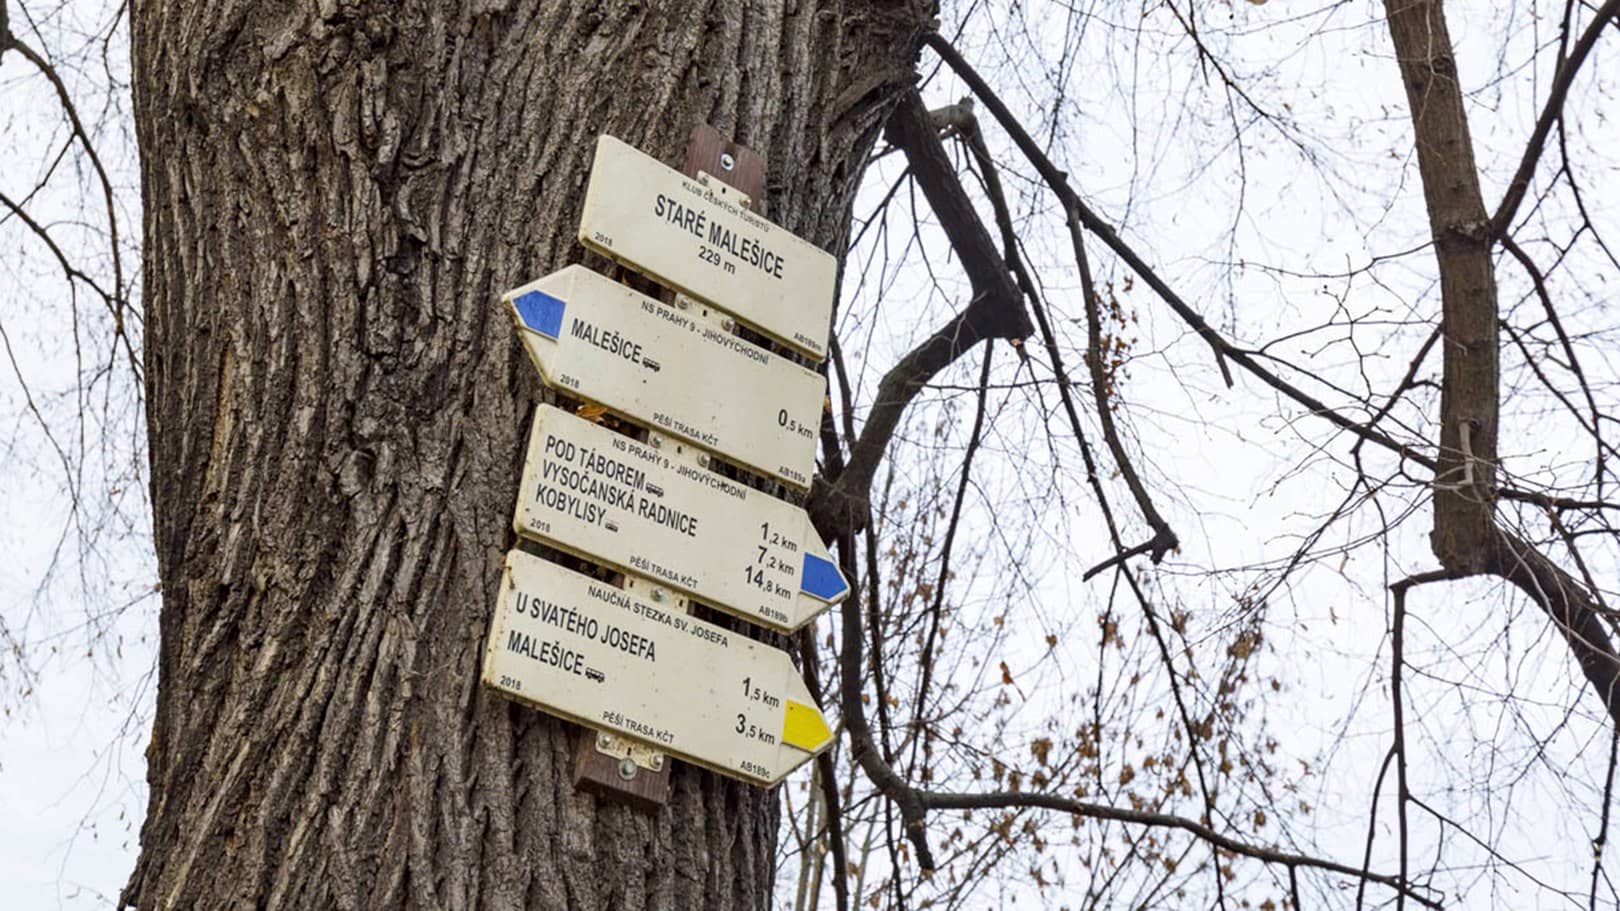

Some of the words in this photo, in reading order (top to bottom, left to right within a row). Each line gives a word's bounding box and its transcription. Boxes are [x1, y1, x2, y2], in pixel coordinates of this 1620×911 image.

[682, 180, 703, 197] KLUB
[595, 232, 613, 247] 2018
[654, 194, 706, 238] STARÉ
[708, 222, 784, 279] MALEŠICE
[698, 246, 721, 267] 229
[724, 262, 736, 275] m
[571, 318, 642, 363] MALEŠICE
[642, 301, 654, 314] NS
[656, 307, 689, 327] PRAHY
[689, 322, 695, 332] 9
[702, 330, 769, 365] JIHOVÝCHODNÍ
[560, 374, 580, 389] 2018
[672, 422, 701, 441] TRASA
[701, 431, 719, 446] KČT
[778, 409, 796, 432] 0,5
[797, 421, 813, 439] km
[546, 435, 575, 462] POD
[580, 447, 645, 492] TÁBOREM
[613, 438, 628, 452] NS
[628, 444, 662, 466] PRAHY
[663, 459, 669, 469] 9
[676, 465, 746, 500] JIHOVÝCHODNÍ
[535, 484, 606, 526] KOBYLISY
[543, 461, 635, 513] VYSOČANSKÁ
[638, 498, 698, 537] RADNICE
[530, 518, 550, 533] 2018
[761, 523, 779, 545] 1,2
[781, 537, 797, 552] km
[630, 555, 650, 571] PĚŠÍ
[649, 561, 678, 583] TRASA
[680, 573, 698, 589] KČT
[758, 546, 776, 570] 7,2
[777, 559, 794, 576] km
[745, 566, 773, 591] 14,8
[774, 583, 791, 600] km
[517, 591, 527, 613] U
[531, 597, 598, 639] SVATÉHO
[601, 627, 655, 662] JOSEFA
[588, 585, 631, 610] NAUČNÁ
[633, 601, 673, 625] STEZKA
[675, 616, 689, 633] SV.
[690, 623, 728, 648] JOSEFA
[508, 630, 584, 675] MALEŠICE
[500, 675, 521, 690] 2018
[742, 678, 761, 701] 1,5
[762, 692, 779, 708] km
[603, 711, 623, 726] PĚŠÍ
[625, 717, 654, 739] TRASA
[655, 728, 674, 744] KČT
[735, 714, 756, 738] 3,5
[758, 728, 775, 745] km
